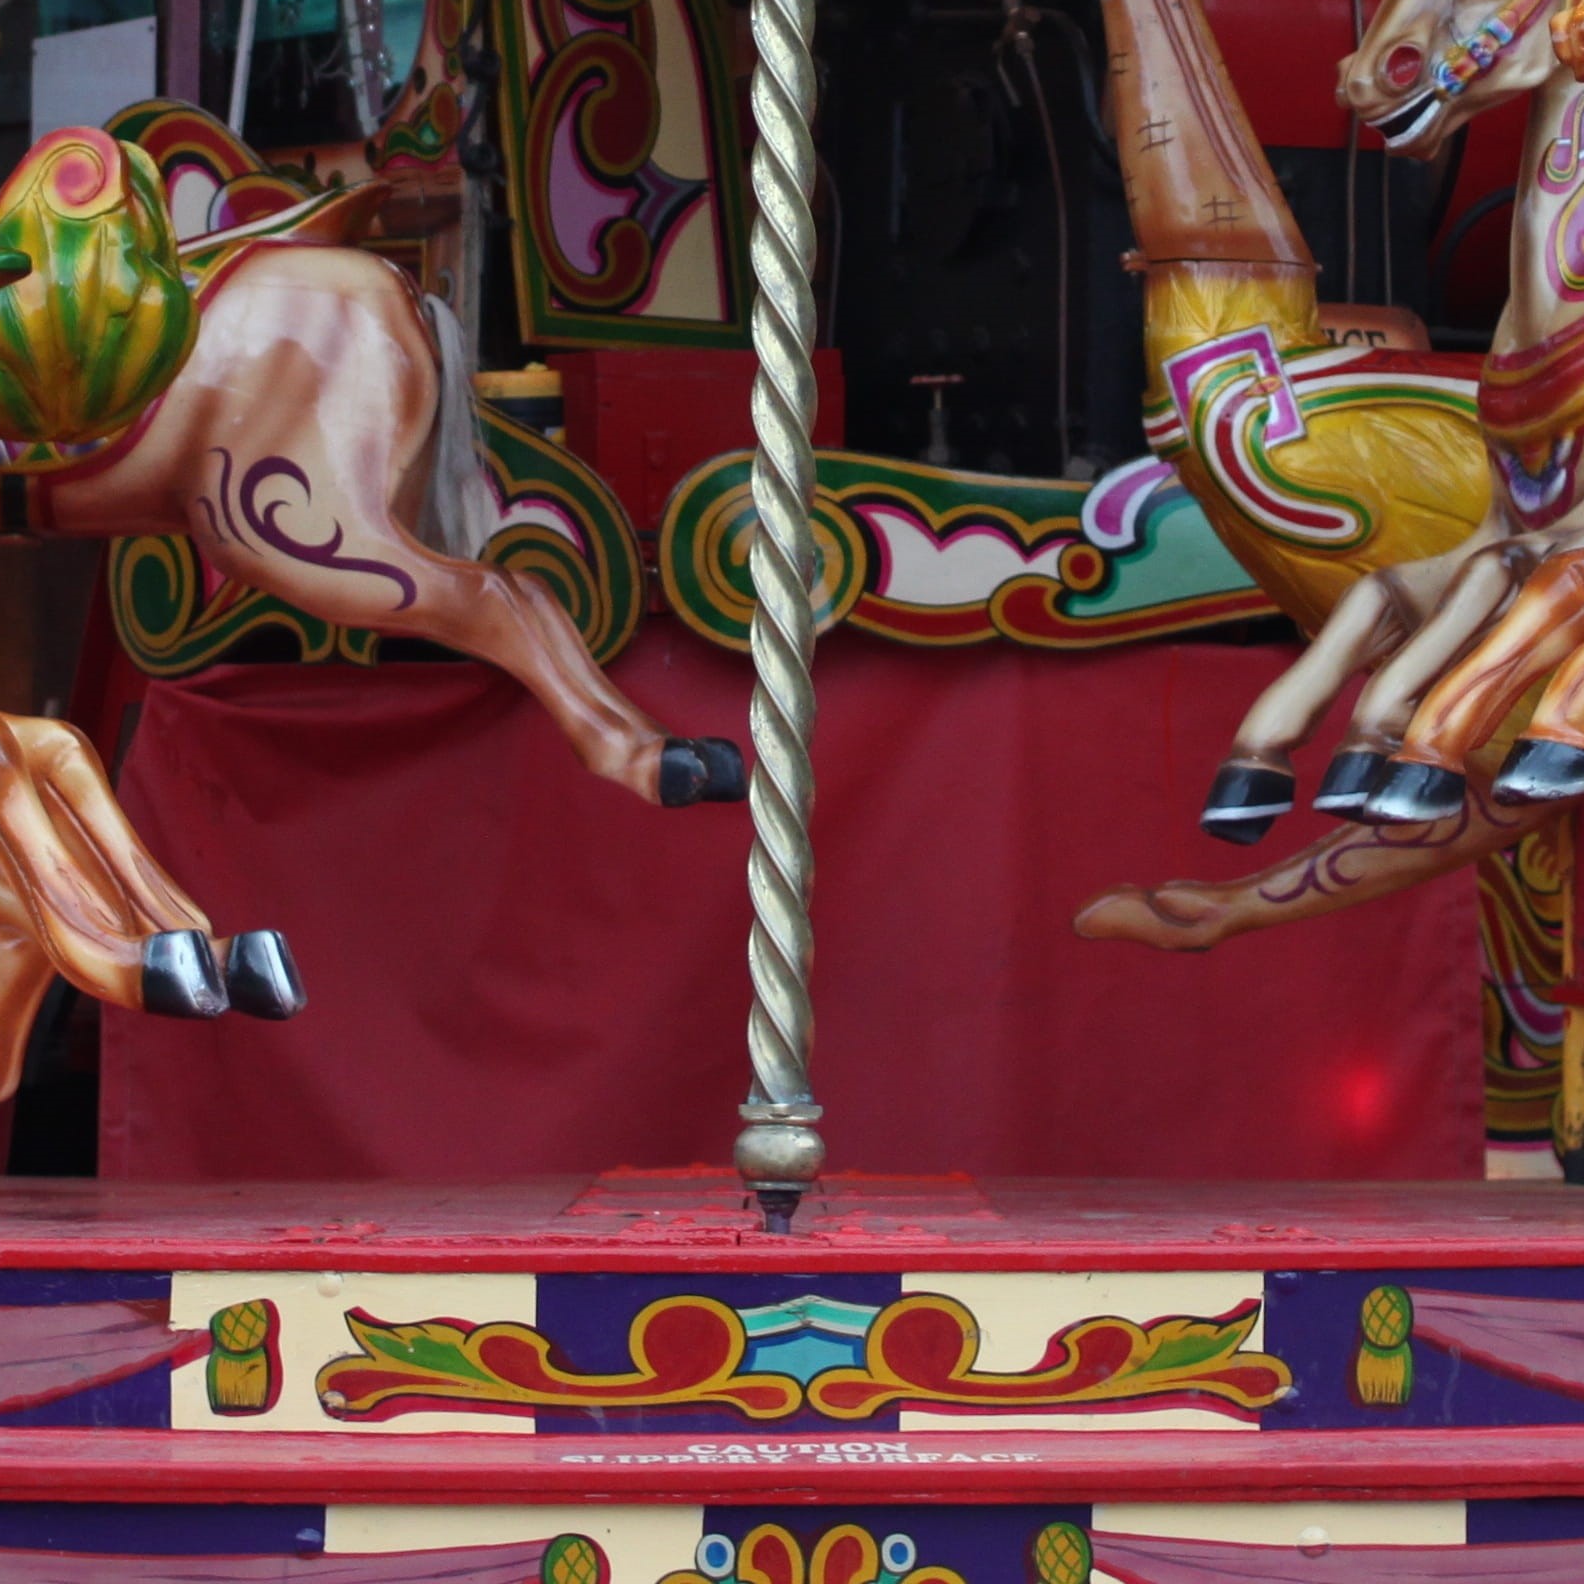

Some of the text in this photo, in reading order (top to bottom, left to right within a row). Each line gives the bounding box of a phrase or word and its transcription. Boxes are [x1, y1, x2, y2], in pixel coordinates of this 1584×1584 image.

[687, 1442, 909, 1454] CAUTION
[560, 1453, 1044, 1464] SLIPPERY SURFACE
